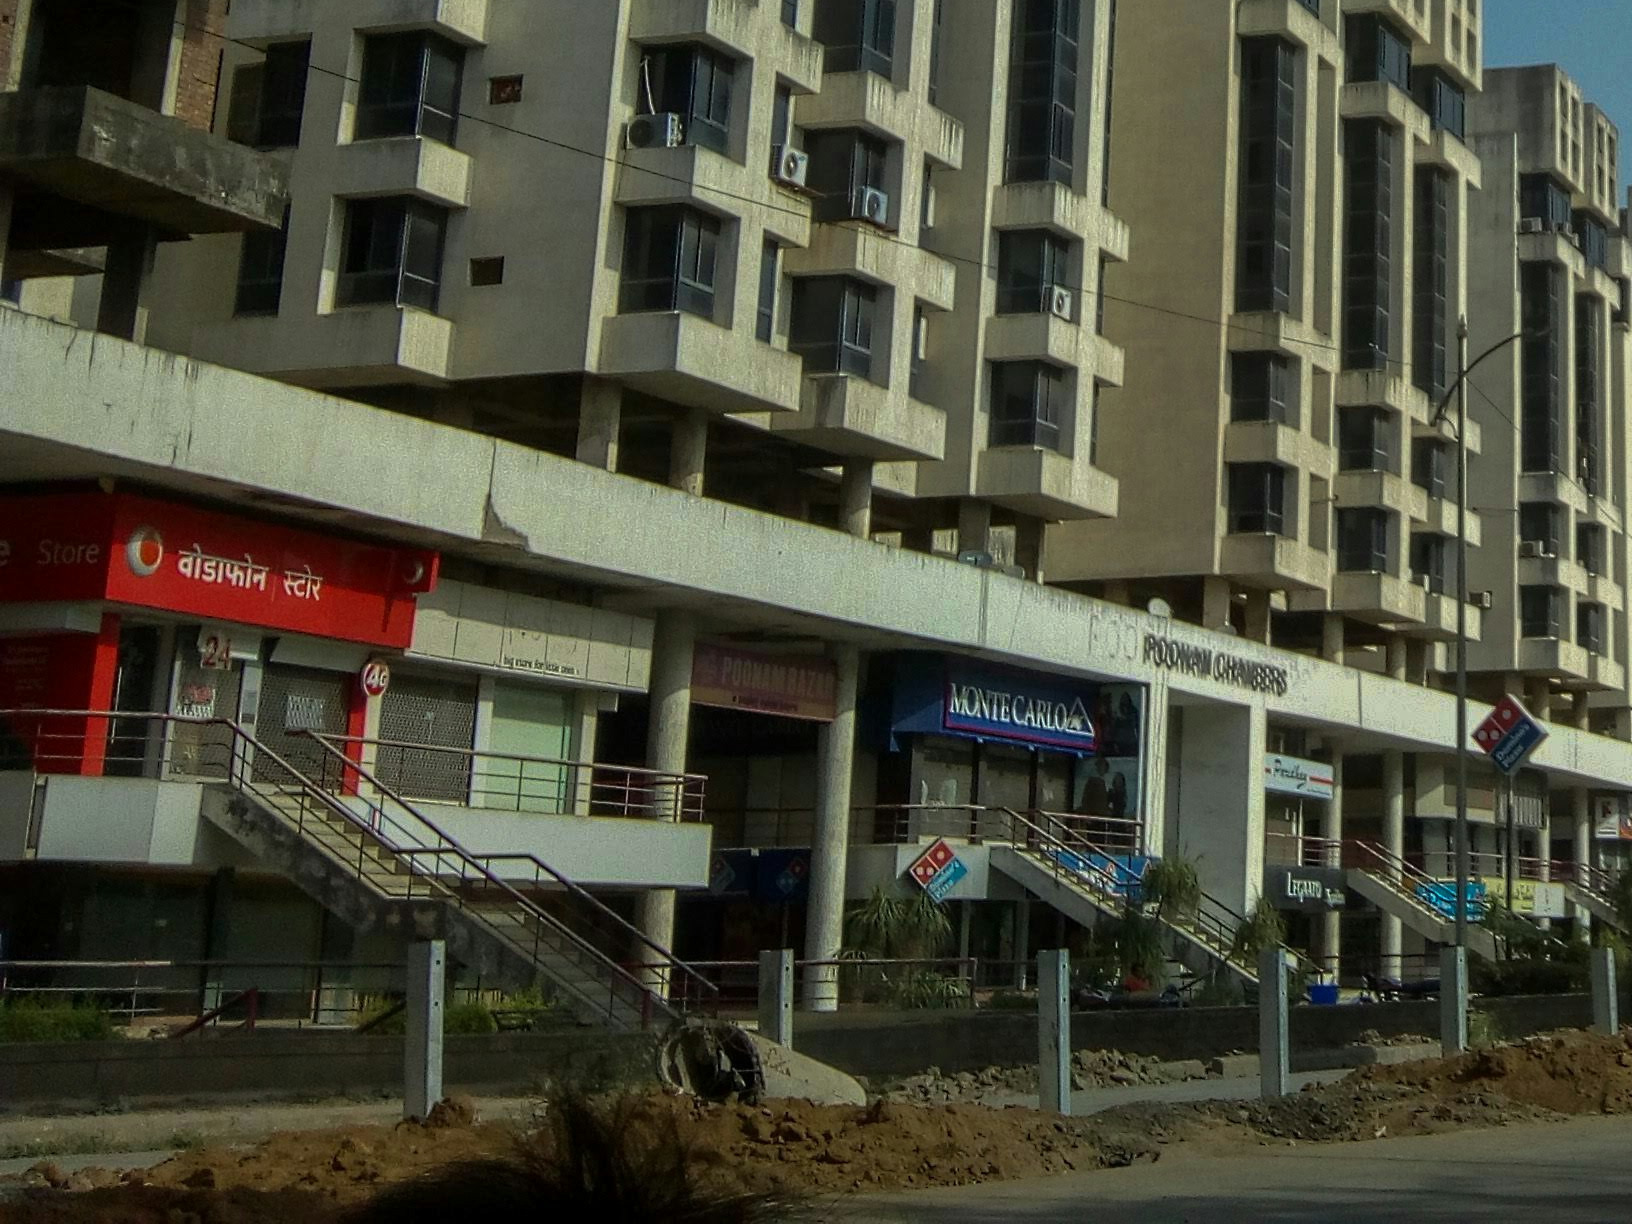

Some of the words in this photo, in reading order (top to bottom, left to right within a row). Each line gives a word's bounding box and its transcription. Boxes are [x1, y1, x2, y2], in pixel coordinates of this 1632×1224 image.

[36, 540, 99, 565] Store
[177, 542, 270, 592] वोडाफोन
[283, 564, 324, 601] स्टोर
[203, 636, 232, 665] 24
[1143, 633, 1213, 676] POONAM
[1213, 651, 1289, 697] CHAMBERS
[950, 682, 1012, 722] MONTE
[1012, 695, 1067, 731] CARLO
